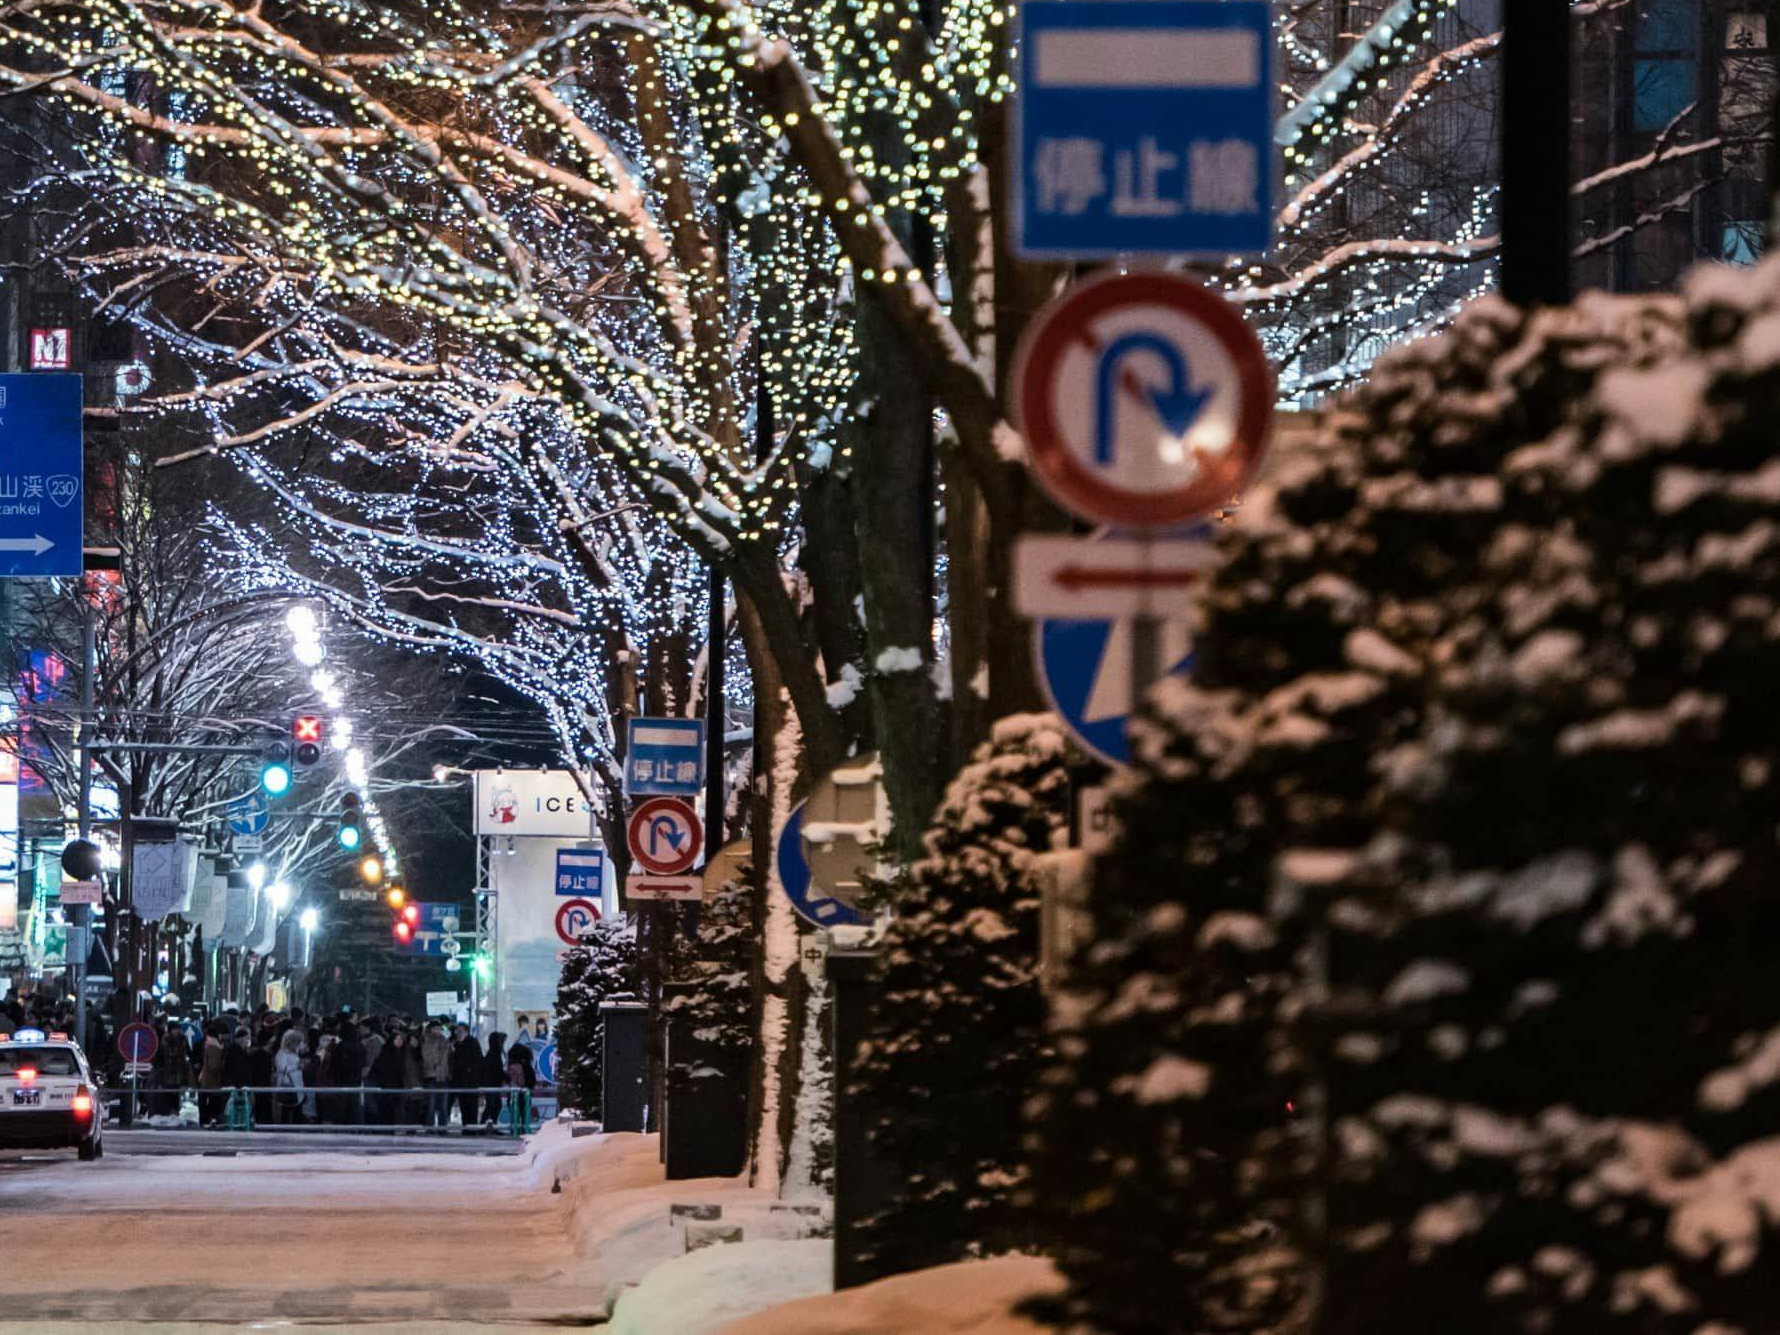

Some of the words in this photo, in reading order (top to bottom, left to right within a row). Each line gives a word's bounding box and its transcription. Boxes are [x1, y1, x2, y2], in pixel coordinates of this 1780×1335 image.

[1032, 137, 1260, 216] 停止線
[52, 480, 74, 496] 230
[634, 760, 697, 782] 停止線
